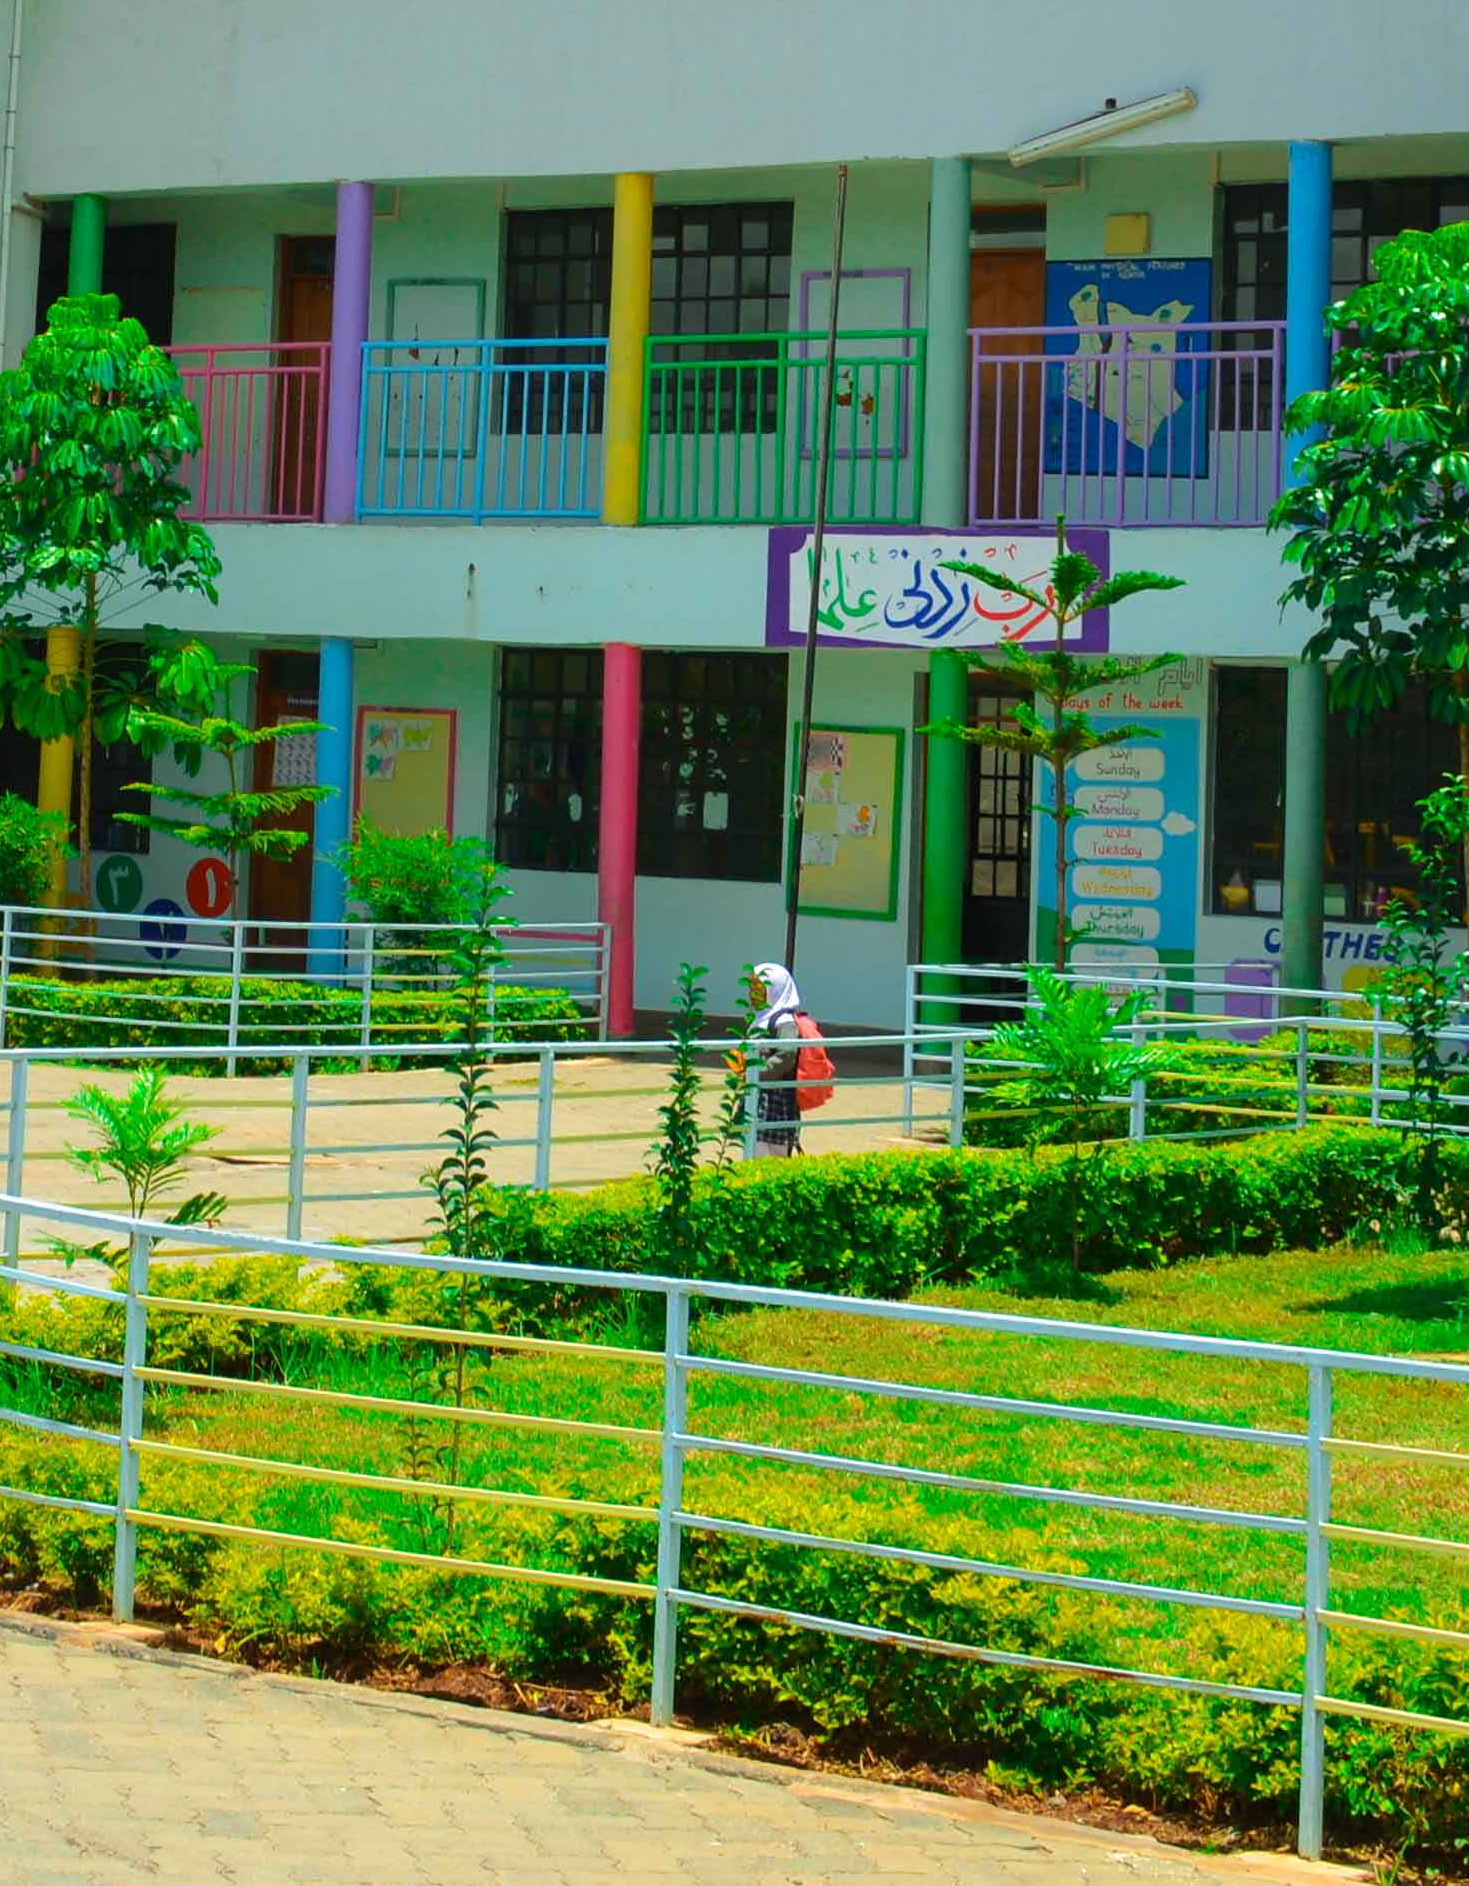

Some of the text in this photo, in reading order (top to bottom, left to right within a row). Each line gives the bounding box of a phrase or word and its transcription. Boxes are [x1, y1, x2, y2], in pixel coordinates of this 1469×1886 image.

[1098, 693, 1113, 708] of
[1123, 693, 1143, 709] the
[1095, 762, 1140, 779] Sunday
[1092, 803, 1140, 819] Monday
[1091, 842, 1143, 858] Tuesday
